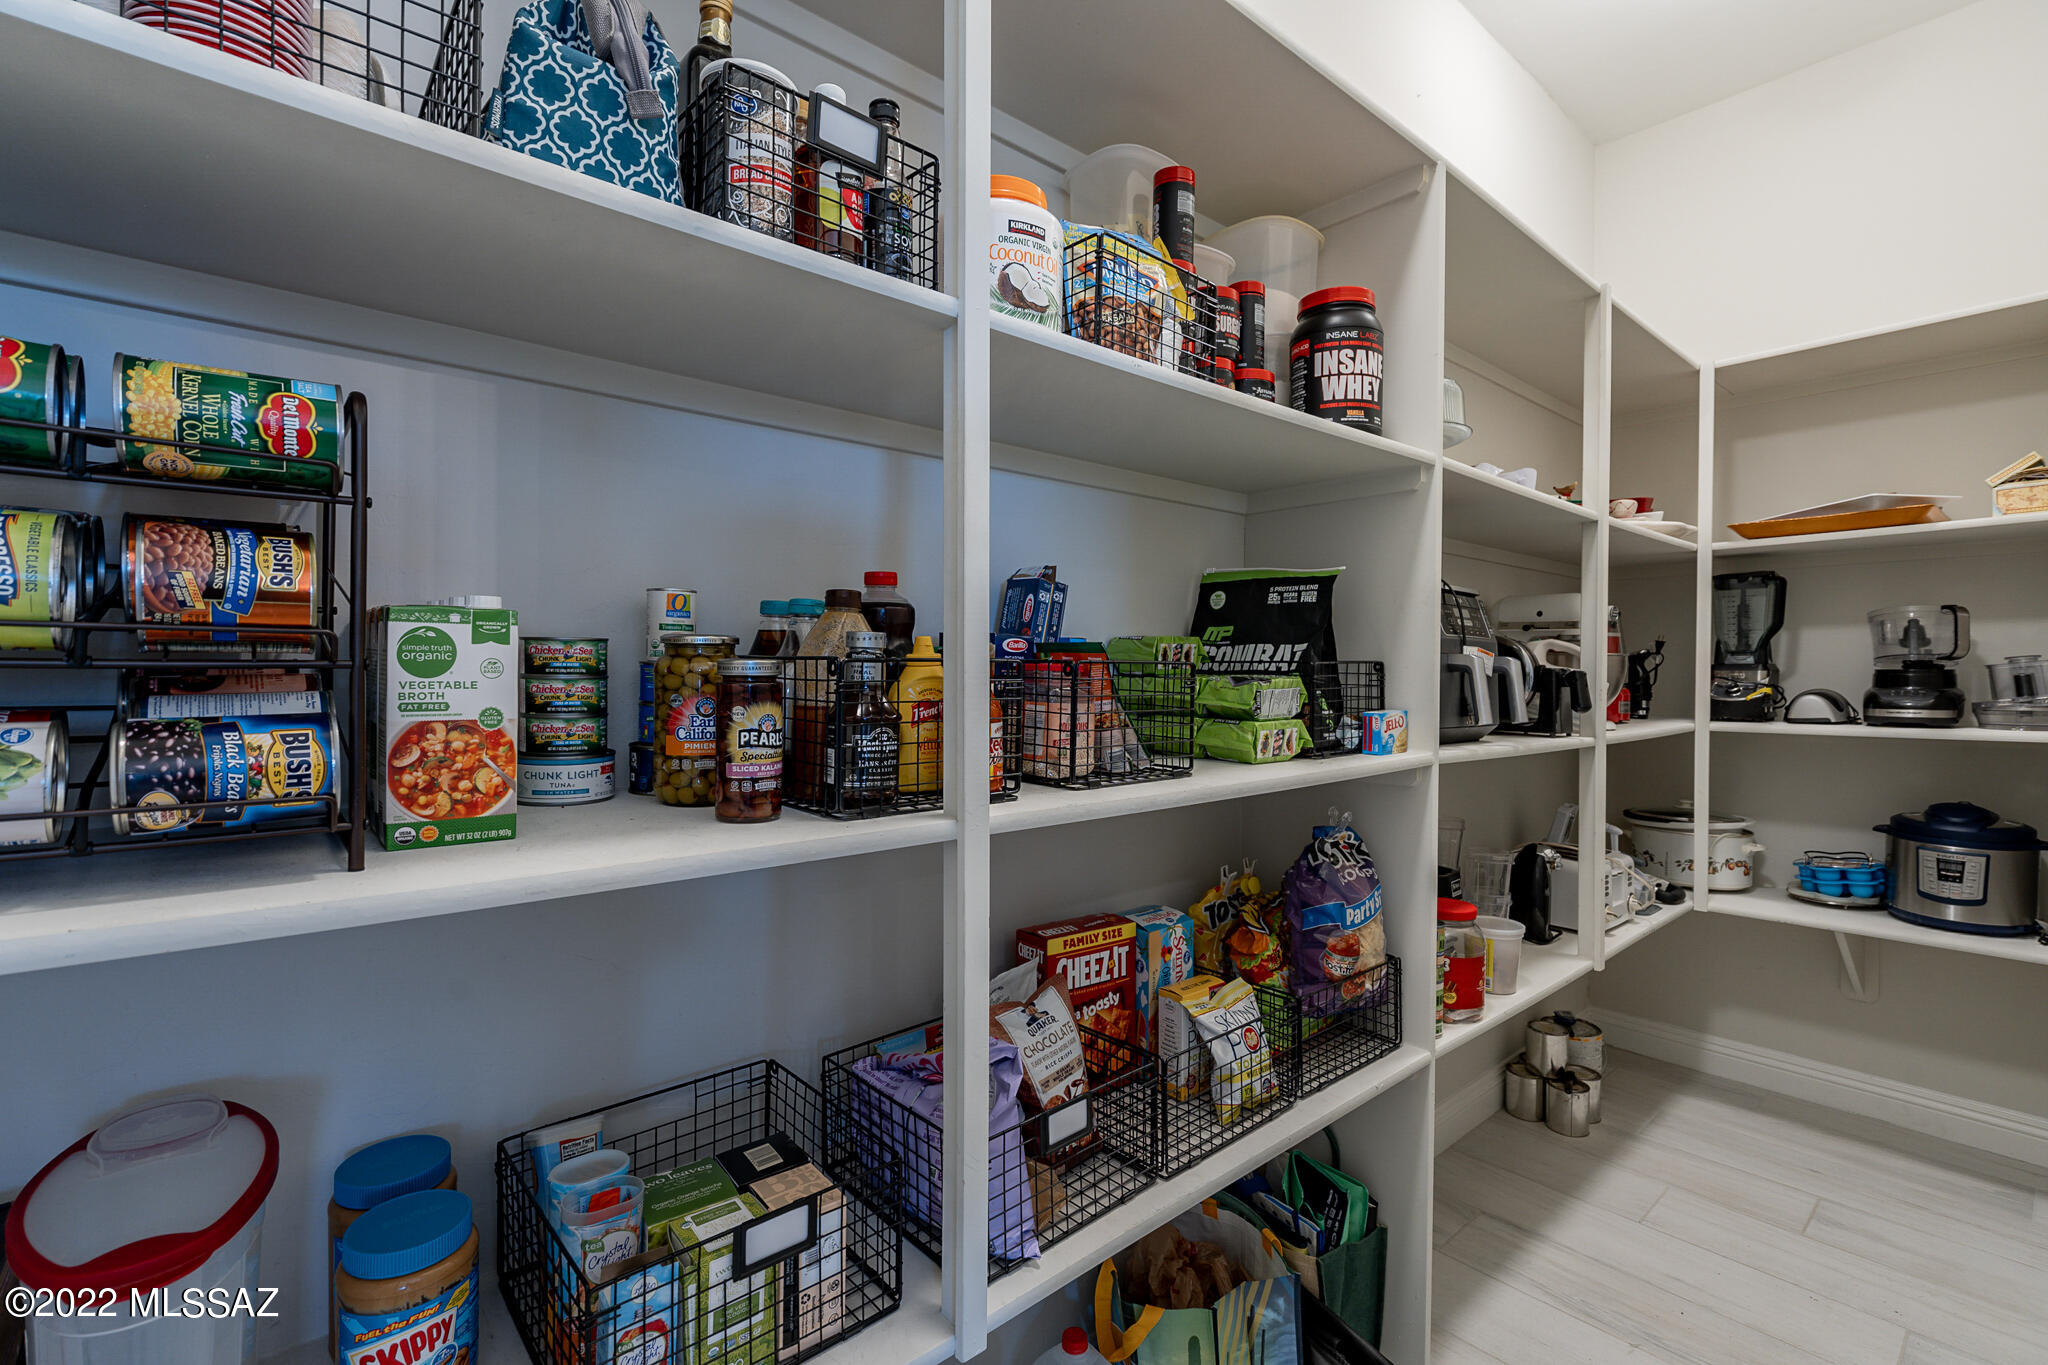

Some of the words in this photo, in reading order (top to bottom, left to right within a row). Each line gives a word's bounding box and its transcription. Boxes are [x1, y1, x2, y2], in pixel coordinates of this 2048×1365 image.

[736, 139, 770, 151] ITALIAN
[733, 168, 763, 180] BREAD
[1010, 221, 1045, 236] KIRKLAND
[998, 235, 1031, 248] ORGANIC
[1031, 240, 1051, 255] VIRGIN
[990, 244, 1044, 267] Coconut
[1046, 255, 1058, 277] Oil
[1325, 331, 1358, 340] INSANE
[1313, 349, 1383, 379] INSANE
[181, 373, 201, 417] KERNEL
[1321, 375, 1380, 402] WHEY
[201, 394, 220, 439] WHOLE
[227, 391, 248, 421] Fresh
[282, 396, 300, 415] Del
[267, 410, 280, 436] Quality
[283, 416, 300, 457] Monte
[249, 438, 260, 466] WIH
[29, 522, 43, 554] VEGETABLE
[25, 554, 40, 593] CLASSICS
[213, 555, 226, 589] BEANS
[235, 531, 255, 598] Vegetarian
[267, 538, 294, 588] BUSH'S
[1300, 595, 1317, 603] FREE
[401, 644, 430, 653] simple
[431, 643, 453, 651] truth
[401, 651, 453, 662] organic
[529, 646, 565, 654] Chicken
[397, 691, 445, 701] BROTH
[398, 680, 479, 691] VEGETABLE
[530, 684, 566, 694] Chicken
[400, 703, 420, 711] FAT
[422, 702, 447, 711] FREE
[531, 724, 567, 733] Chicken
[211, 745, 223, 771] Frijoles
[222, 731, 244, 768] Black
[273, 752, 281, 785] BEST
[523, 770, 562, 780] CHUNK
[567, 769, 599, 779] LIGHT
[212, 772, 223, 797] Negros
[224, 773, 246, 813] Beas
[444, 834, 455, 842] NET
[466, 833, 473, 841] 32
[473, 832, 482, 840] OZ
[1346, 899, 1375, 926] Party
[1063, 933, 1099, 950] FAMILY
[1101, 928, 1123, 940] SIZE
[1082, 991, 1120, 1020] toasty
[1027, 1014, 1058, 1037] QUAKER
[1023, 1020, 1074, 1059] CHOCOLATE
[1045, 1060, 1057, 1070] RICE
[1057, 1049, 1073, 1062] CRISPS
[643, 1178, 666, 1189] wo
[667, 1163, 713, 1179] leaves
[584, 1242, 602, 1252] tea
[588, 1236, 629, 1271] Crystal
